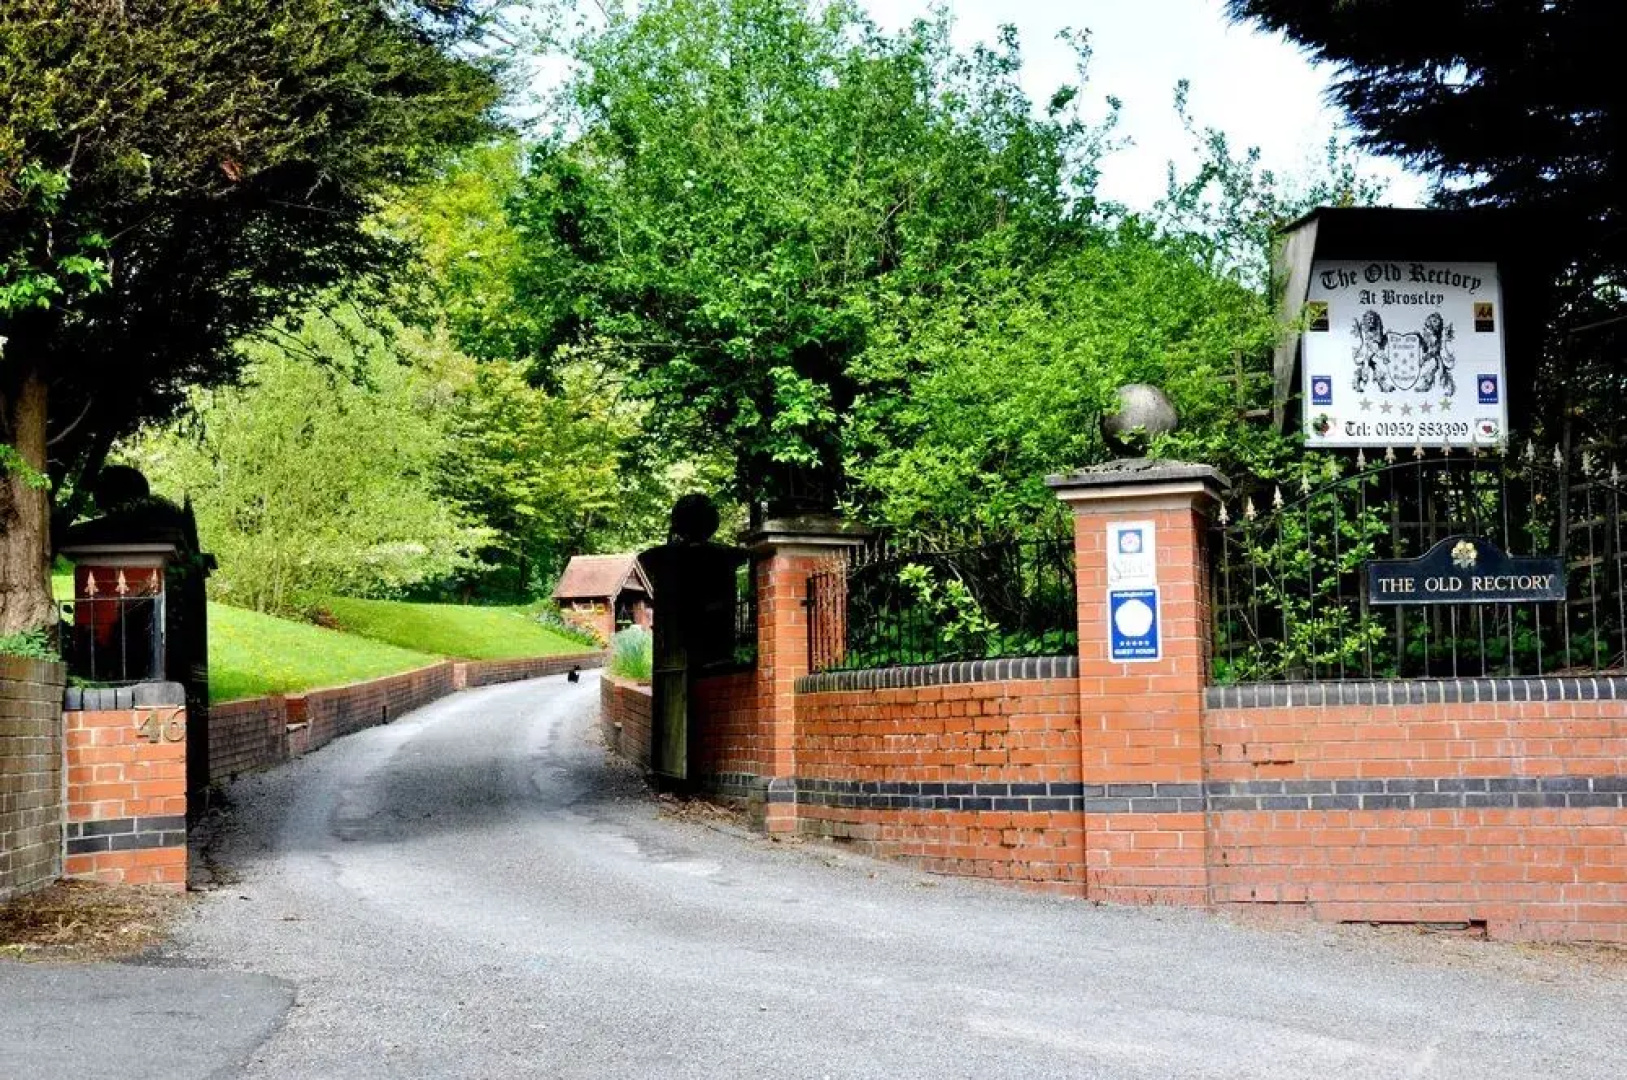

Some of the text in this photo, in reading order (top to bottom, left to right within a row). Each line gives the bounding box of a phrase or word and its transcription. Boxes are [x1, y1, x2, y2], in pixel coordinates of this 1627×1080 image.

[1320, 262, 1481, 294] The Old Rectory
[1359, 290, 1444, 308] At Broseley
[1345, 421, 1468, 437] Tel: 01952 883399
[1378, 574, 1553, 593] THE OLD RECTORY
[137, 709, 186, 743] 46
